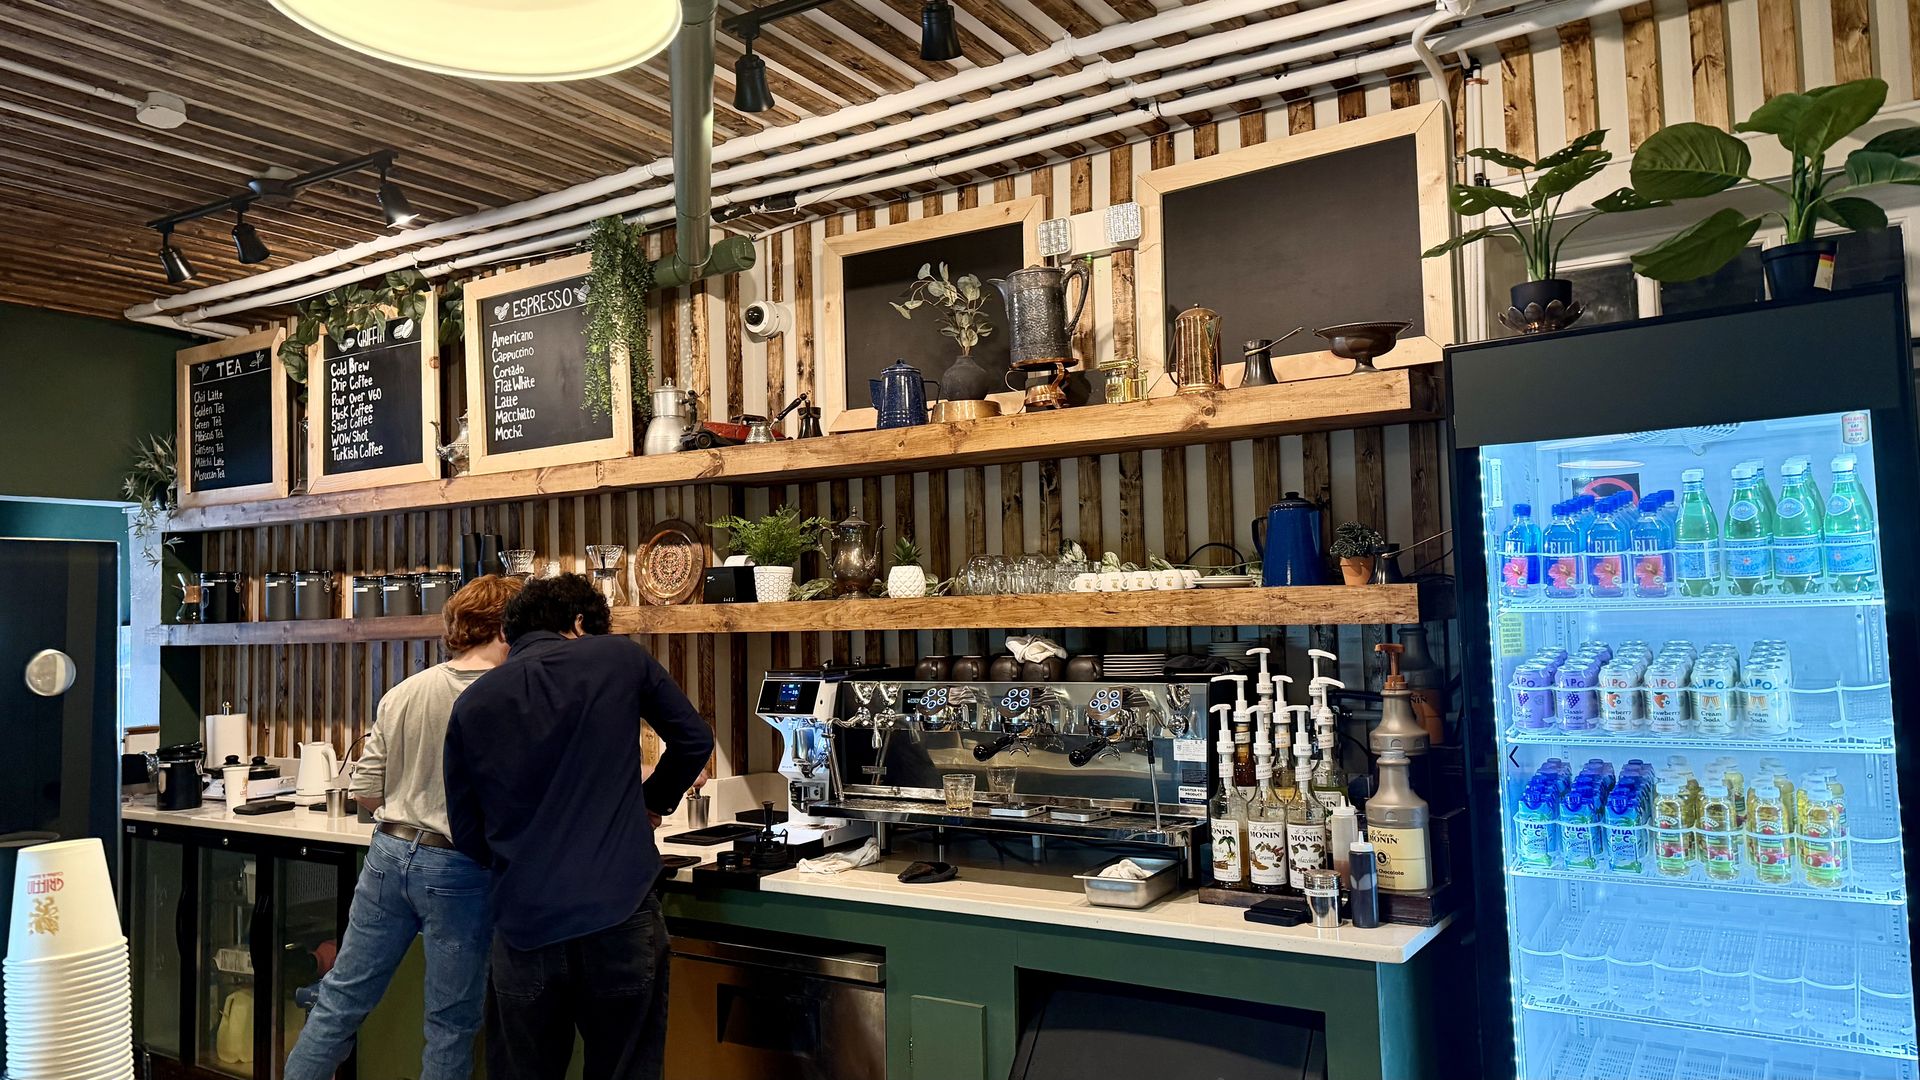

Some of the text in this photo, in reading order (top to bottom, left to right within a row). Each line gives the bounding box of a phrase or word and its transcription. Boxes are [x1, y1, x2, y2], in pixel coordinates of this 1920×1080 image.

[512, 288, 572, 318] ESPRESSO
[492, 330, 534, 348] Americano
[492, 346, 534, 364] Cappuccino
[216, 359, 242, 377] TEA
[330, 358, 370, 376] Cold Brew
[493, 364, 524, 380] Cortado
[332, 375, 372, 392] Drip Coffee
[494, 376, 536, 394] Flat White
[208, 390, 222, 400] Latte
[332, 388, 382, 406] Pour Over V60
[494, 394, 518, 410] Latte
[194, 402, 224, 418] Golden Tea
[350, 402, 374, 418] Coffee
[495, 408, 536, 425] Macchiato
[212, 416, 222, 426] Tea
[332, 415, 373, 434] Sand Coffee
[214, 428, 224, 439] Tea
[332, 429, 368, 447] WOW Shot
[494, 424, 524, 442] Mocha
[215, 443, 224, 452] Tea
[360, 442, 384, 458] Coffee
[216, 468, 225, 479] Tea
[1370, 835, 1398, 844] MONIN
